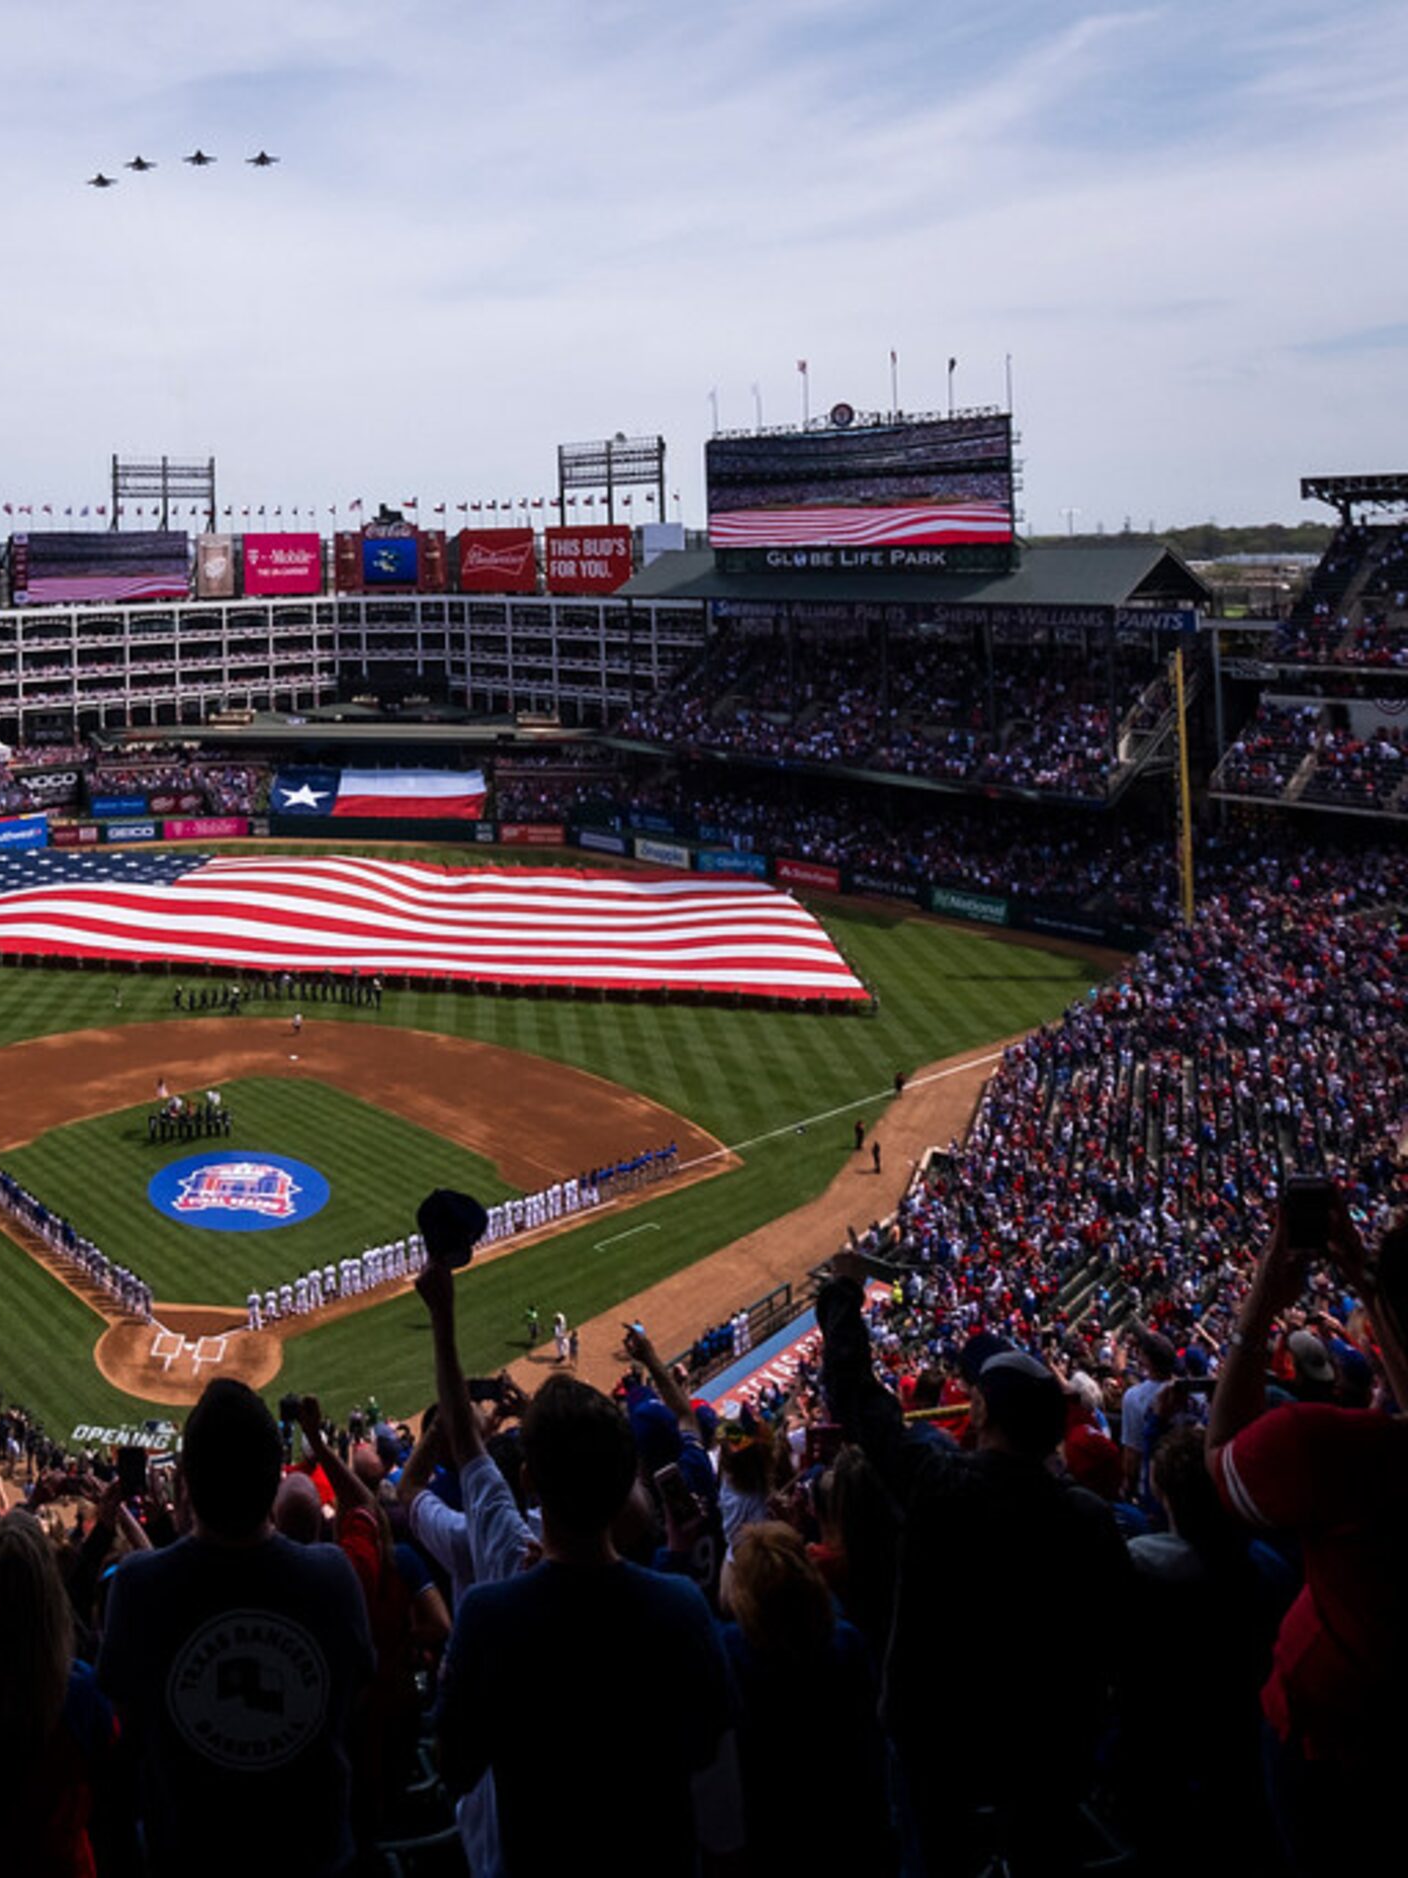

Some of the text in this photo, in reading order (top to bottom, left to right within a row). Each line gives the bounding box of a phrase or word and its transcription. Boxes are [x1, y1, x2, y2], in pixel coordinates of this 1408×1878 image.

[549, 538, 626, 556] THIS BUD'S
[841, 550, 884, 566] LIFE
[890, 550, 946, 566] PARK
[550, 561, 578, 578] FOR
[1114, 610, 1185, 631] PAINTS
[72, 1423, 172, 1450] OPENING
